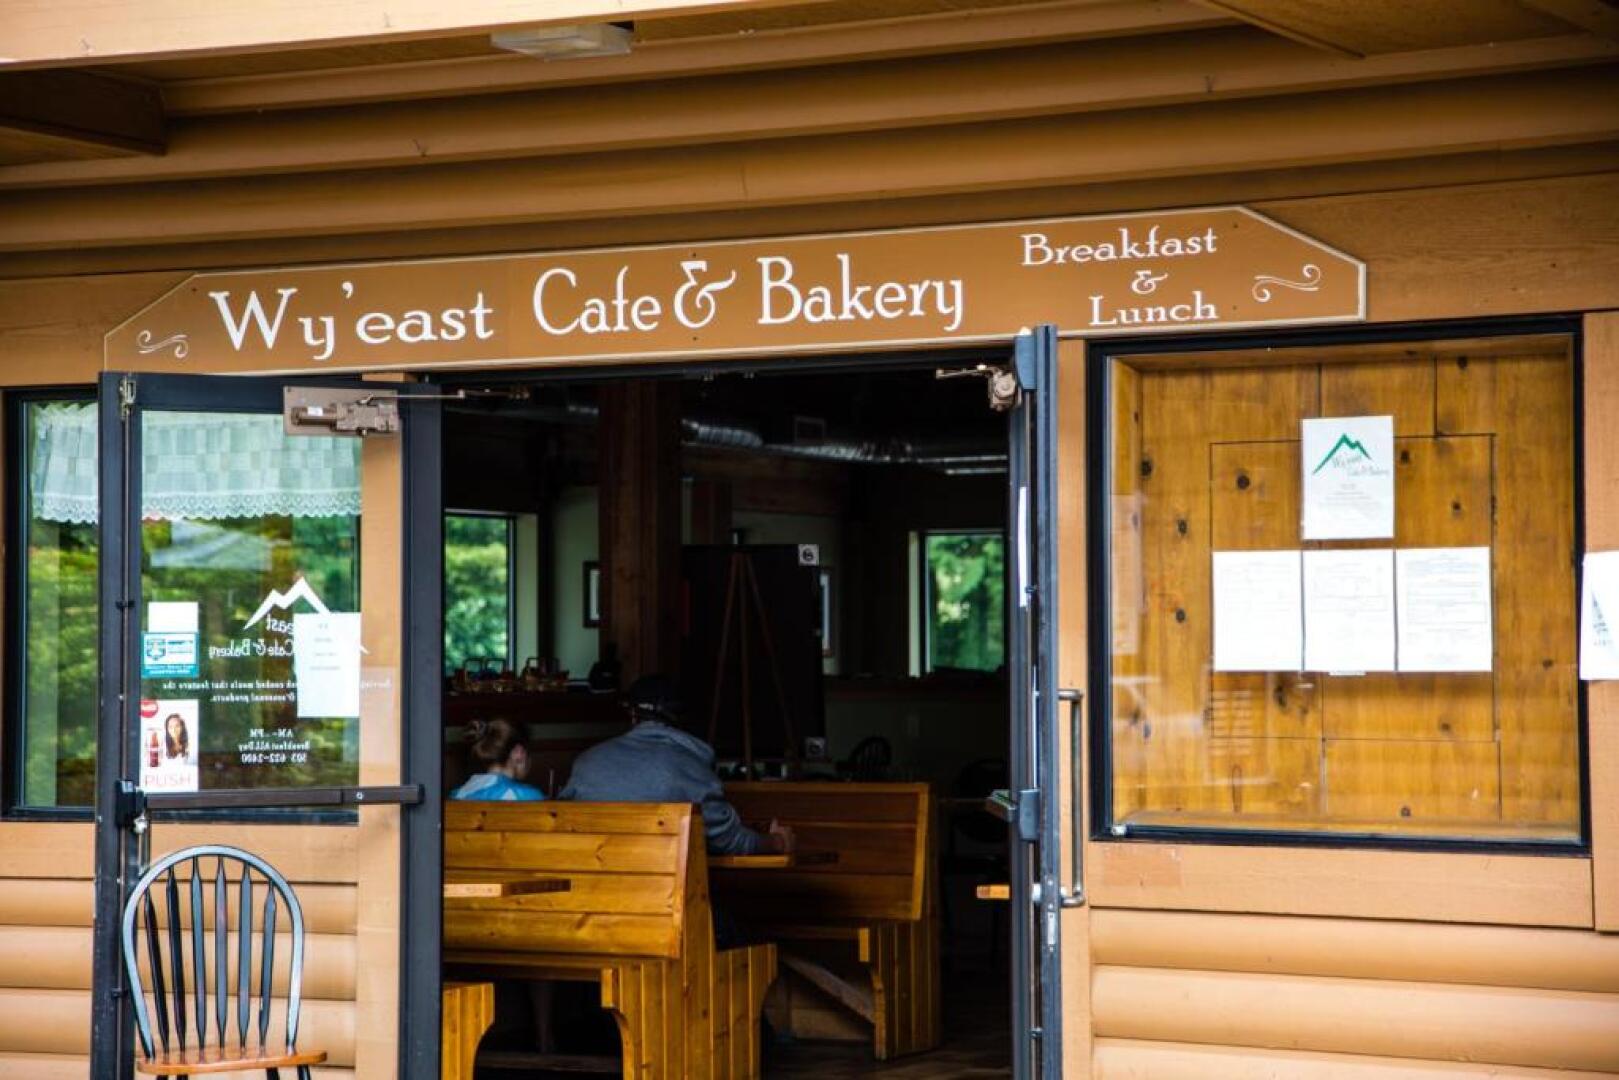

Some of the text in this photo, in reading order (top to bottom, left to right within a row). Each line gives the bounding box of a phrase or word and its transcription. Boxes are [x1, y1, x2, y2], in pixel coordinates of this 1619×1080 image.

[1020, 226, 1219, 267] Breakfast
[1130, 269, 1169, 295] &
[208, 252, 966, 362] Wy'east Cafe & Bakery
[1088, 288, 1219, 328] Lunch
[144, 773, 192, 787] PUSH
